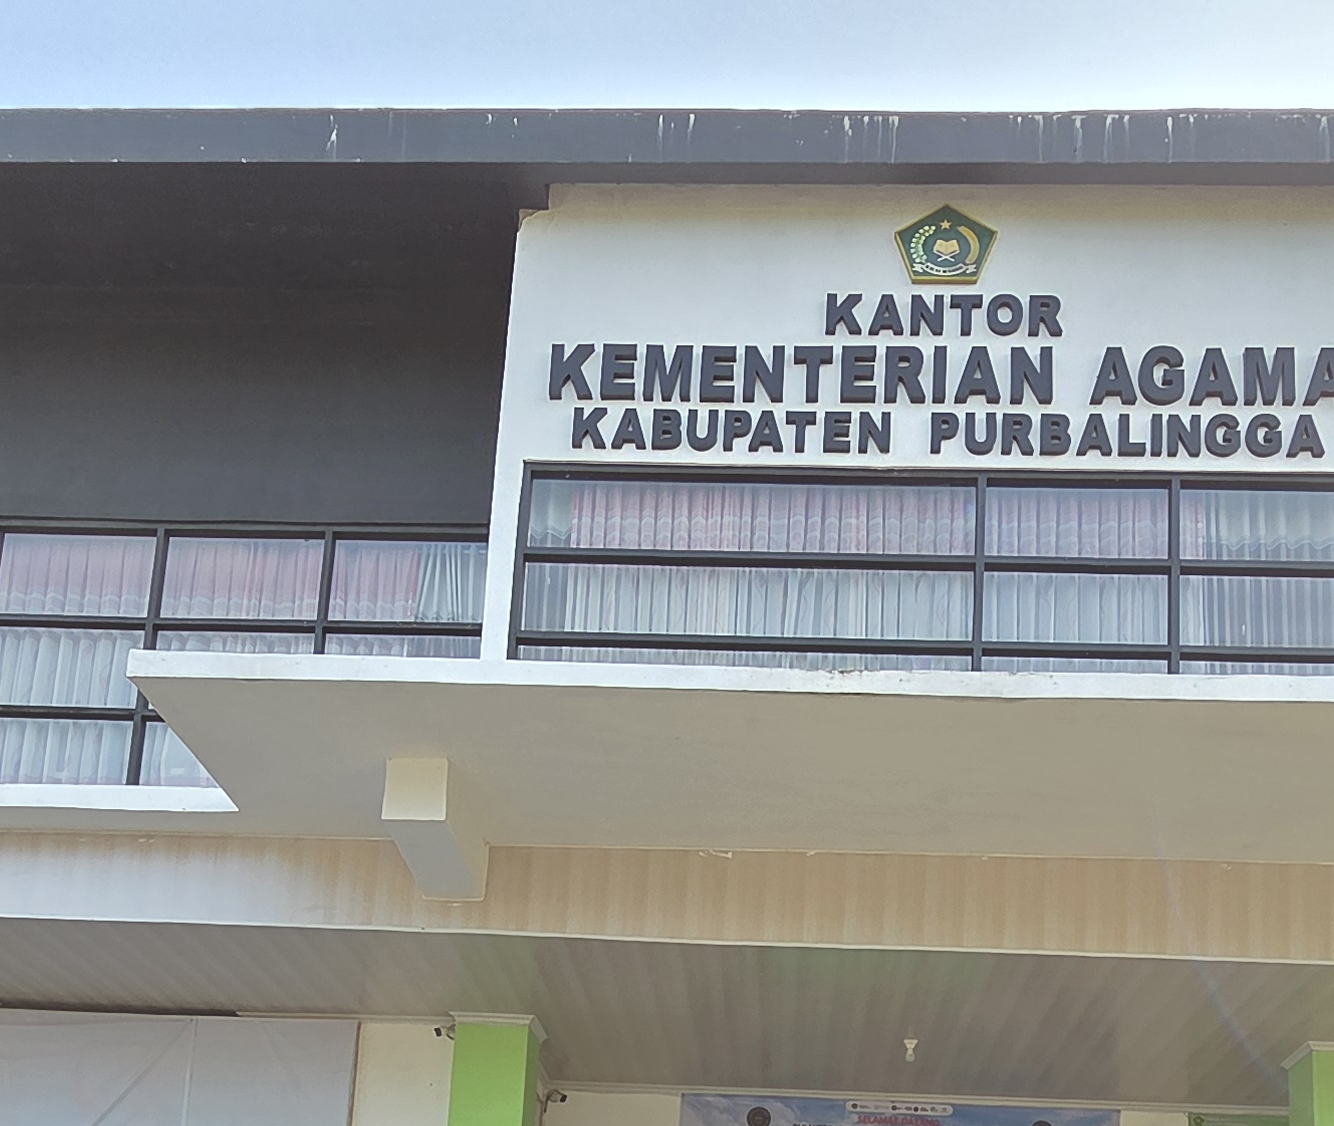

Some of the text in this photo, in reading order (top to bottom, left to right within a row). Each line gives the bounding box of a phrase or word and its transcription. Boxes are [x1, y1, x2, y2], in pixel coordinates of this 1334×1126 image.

[824, 292, 1063, 337] KANTOR
[548, 343, 1054, 405] KEMENTERIAN
[571, 407, 1326, 458] KABUPATEN PURBALINGGA
